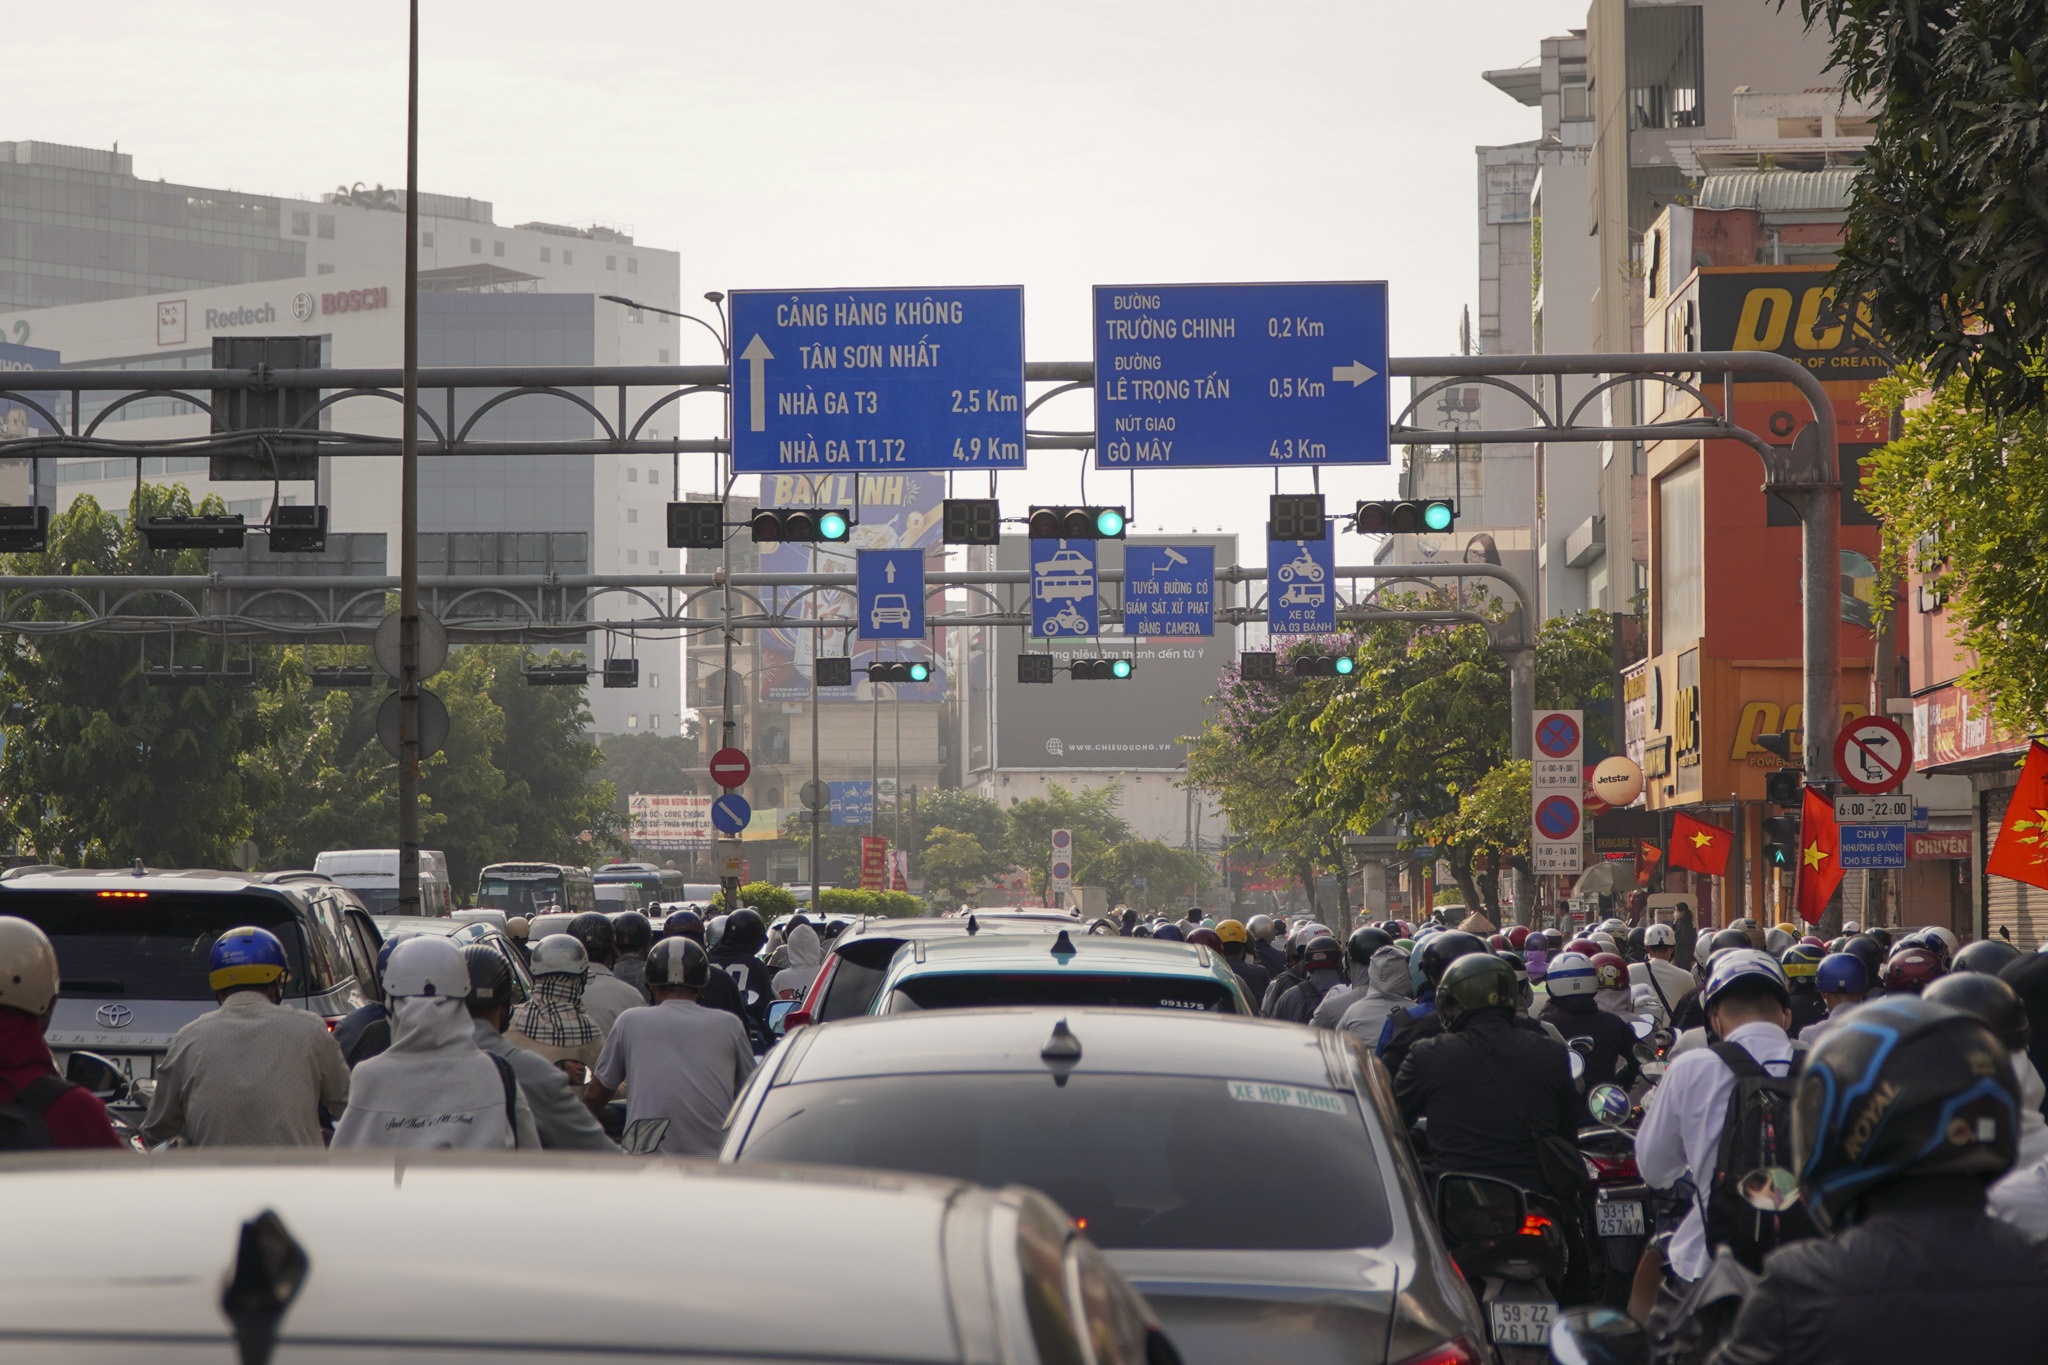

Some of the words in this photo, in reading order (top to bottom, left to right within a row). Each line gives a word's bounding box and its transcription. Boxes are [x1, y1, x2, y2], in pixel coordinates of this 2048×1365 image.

[321, 286, 387, 315] BOSCH
[1114, 292, 1161, 310] ĐƯỜNG
[205, 301, 275, 329] Reetech
[777, 296, 828, 327] CẢNG
[835, 296, 887, 326] HÀNG
[895, 297, 963, 325] KHÔNG
[1106, 314, 1177, 340] TRƯỜNG
[1182, 318, 1235, 339] CHINH
[1268, 317, 1292, 338] 0,2
[1296, 317, 1324, 337] Km
[800, 342, 836, 369] TÂN
[844, 344, 882, 368] SƠN
[890, 334, 940, 367] NHẤT
[1114, 352, 1161, 371] ĐƯỜNG
[1808, 357, 1825, 368] OF
[1106, 376, 1128, 401] LÊ
[1132, 379, 1190, 404] TRỌNG
[1197, 371, 1230, 399] TẤN
[1269, 378, 1292, 399] 0,5
[1297, 378, 1325, 398] Km
[778, 385, 818, 415] NHÀ
[824, 392, 849, 414] GA
[854, 391, 878, 414] T3
[951, 390, 980, 414] 2,5
[987, 390, 1018, 412] Km
[1115, 414, 1142, 431] NÚT
[1145, 417, 1176, 431] GIAO
[779, 433, 819, 463] NHÀ
[825, 440, 850, 463] GA
[856, 439, 906, 465] T1,T2
[952, 438, 981, 462] 4,9
[988, 437, 1019, 460] Km
[1107, 438, 1134, 462] GÒ
[1136, 438, 1173, 461] MÂY
[1269, 439, 1293, 460] 4,3
[1298, 438, 1326, 458] Km
[1132, 577, 1159, 594] TUYẾN
[1163, 578, 1192, 594] ĐƯỜNG
[1196, 579, 1208, 594] CÓ
[1126, 598, 1147, 614] GIÁM
[1187, 602, 1210, 616] PHẠT
[1289, 610, 1302, 619] XE
[1304, 610, 1315, 619] 02
[1166, 622, 1200, 634] CAMERA
[1273, 621, 1286, 632] VÀ
[1289, 623, 1300, 632] 03
[1303, 621, 1332, 632] BÁNH
[1122, 649, 1155, 659] thanh
[1158, 649, 1180, 659] đến
[1183, 649, 1196, 658] từ
[1198, 649, 1205, 658] Ý
[1068, 743, 1171, 751] WWW.CHIEUDUONG.VN
[1598, 775, 1630, 784] Jetstar
[1881, 828, 1889, 838] Ý
[1596, 837, 1630, 848] SKINCARE
[1843, 841, 1875, 852] NHƯỜNG
[1877, 841, 1903, 851] ĐƯỜNG
[1916, 837, 1967, 854] CHUYÊN
[1844, 856, 1860, 865] CHO
[1862, 856, 1871, 864] XE
[1233, 1083, 1255, 1100] XE
[1845, 1081, 1901, 1160] ROYAL
